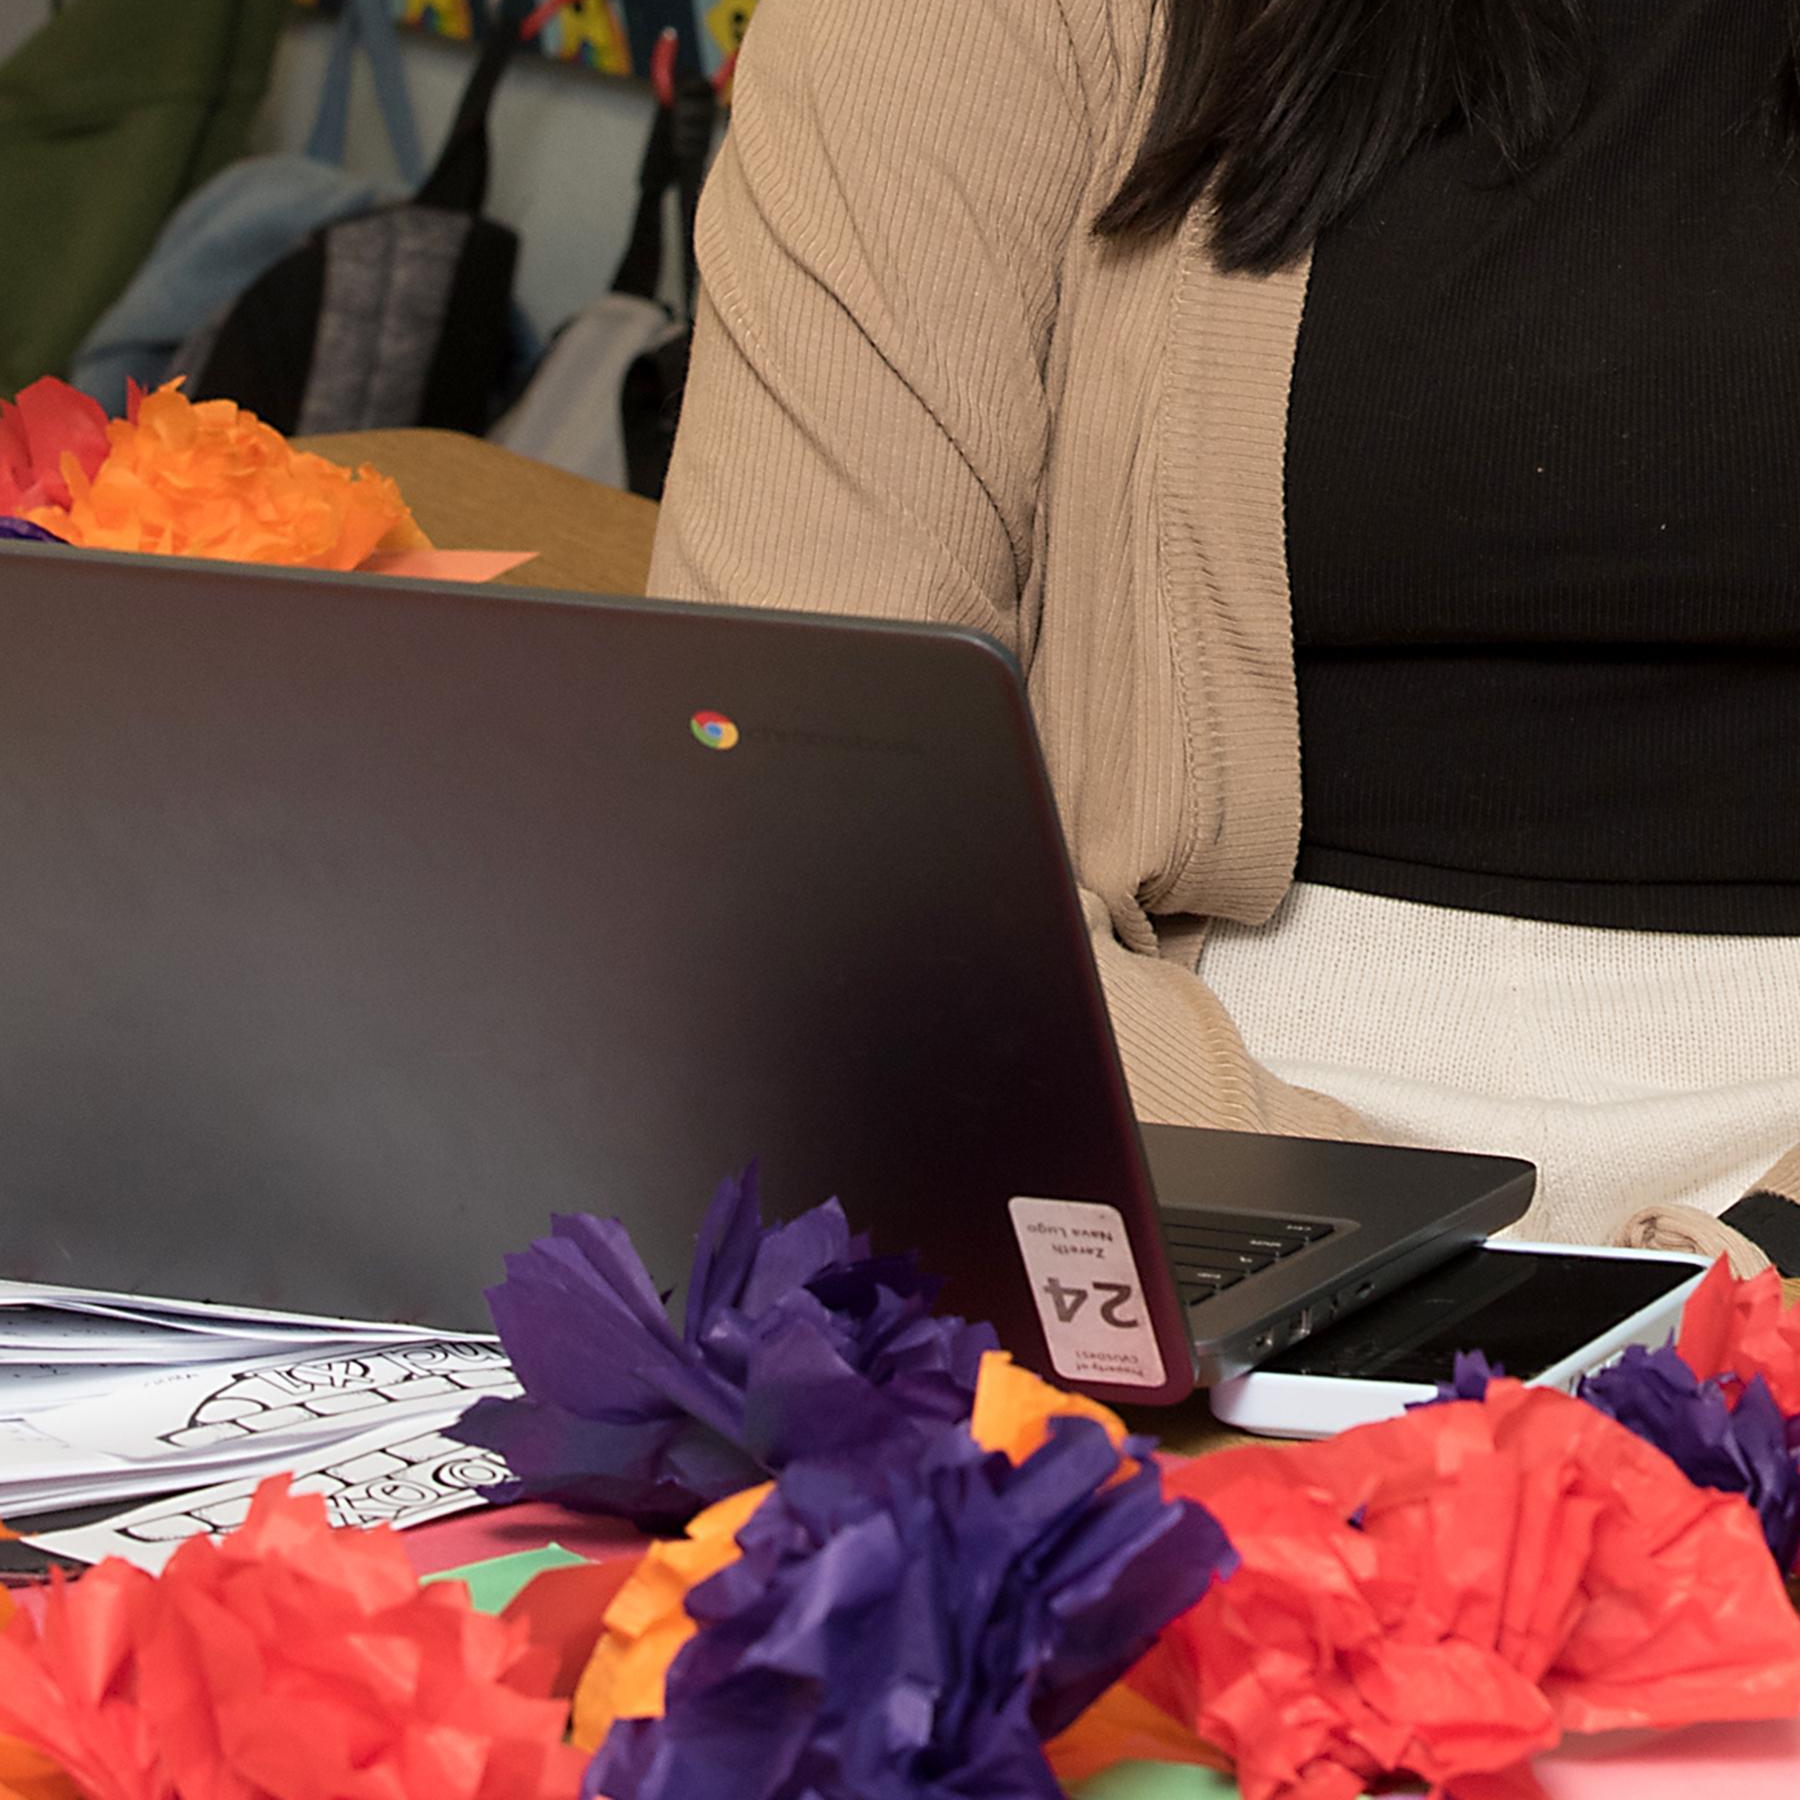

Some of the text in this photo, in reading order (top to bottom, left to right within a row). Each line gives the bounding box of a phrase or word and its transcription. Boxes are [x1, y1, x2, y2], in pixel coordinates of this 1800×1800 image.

[1026, 1221, 1114, 1243] Nava Lugo
[1043, 1276, 1140, 1329] 24
